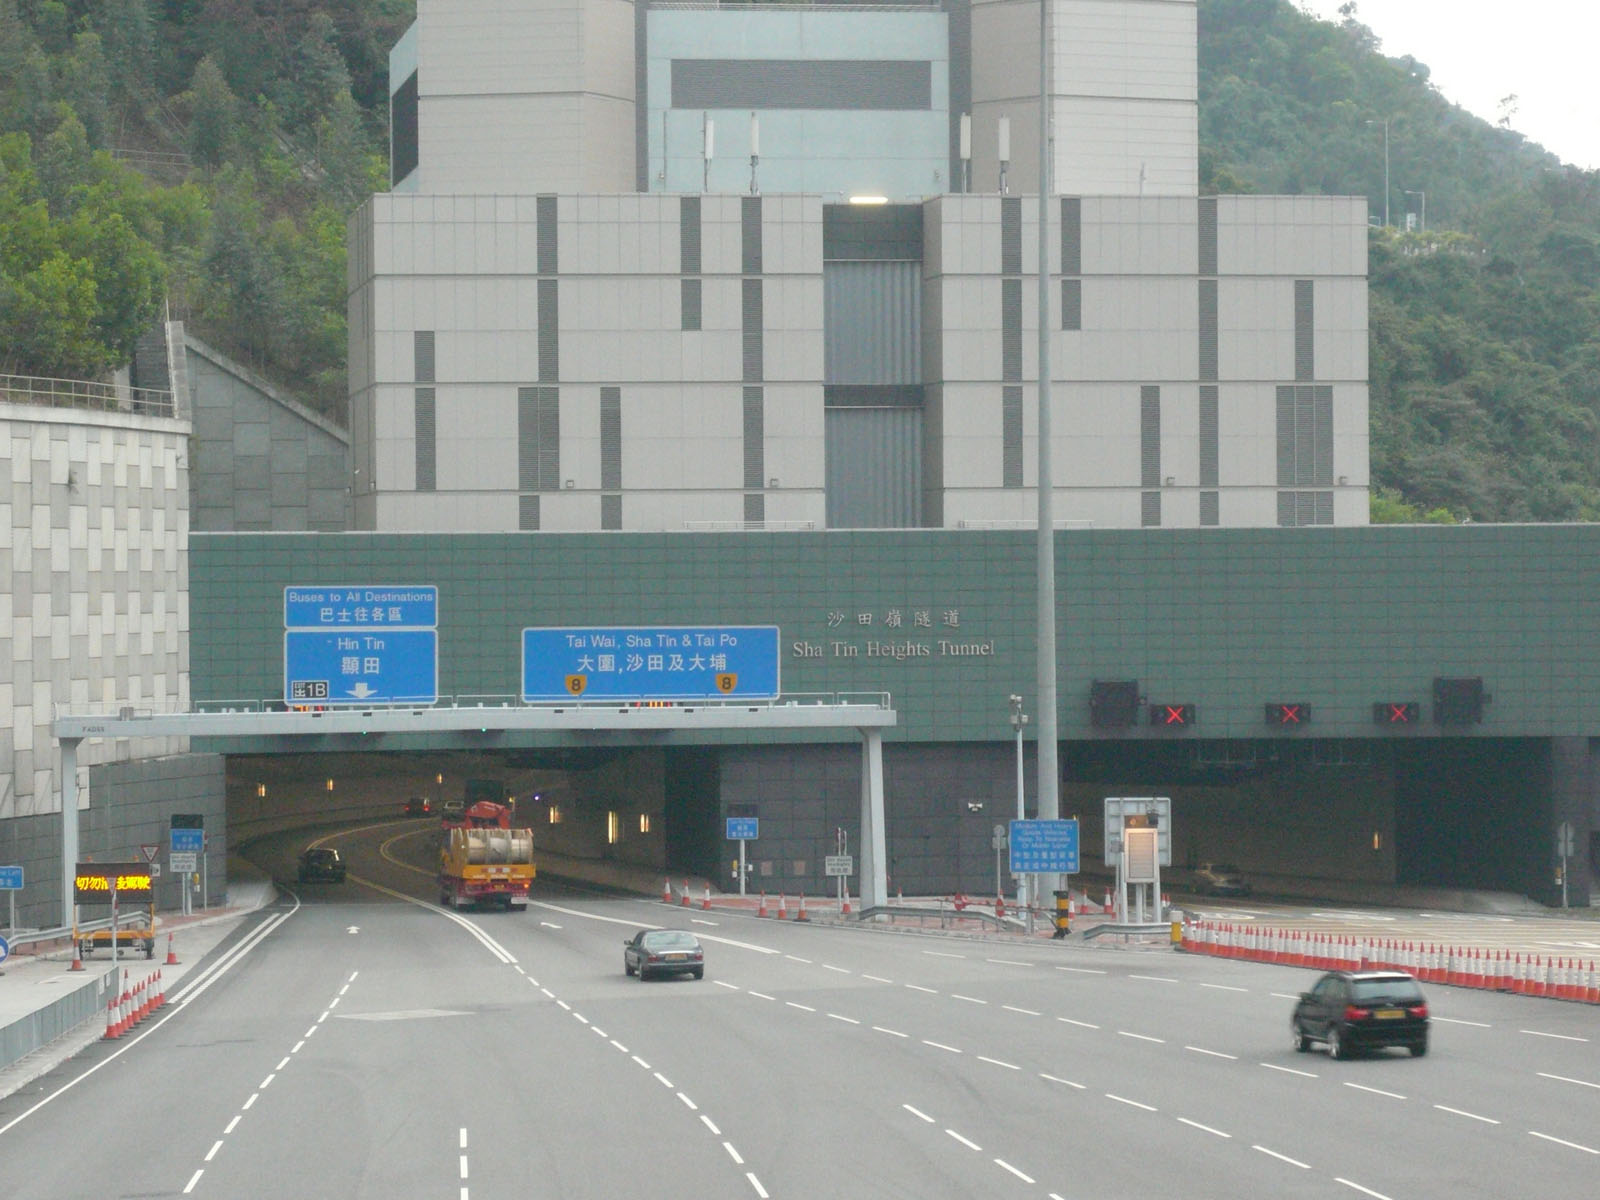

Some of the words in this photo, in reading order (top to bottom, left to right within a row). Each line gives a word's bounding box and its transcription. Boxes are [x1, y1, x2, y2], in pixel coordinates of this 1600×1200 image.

[289, 592, 324, 602] Buses
[330, 592, 341, 602] to
[346, 592, 360, 601] All
[365, 591, 433, 602] Destinations
[320, 606, 403, 622] 巴士往各區
[827, 609, 960, 629] 沙田嶺隧道
[338, 637, 359, 650] Hin
[363, 636, 385, 650] Tin
[565, 634, 586, 648] Tai
[591, 634, 621, 649] Wai,
[626, 634, 651, 648] Sha
[656, 633, 677, 648] Tin
[682, 634, 693, 647] &
[695, 633, 715, 647] Tai
[720, 633, 737, 647] Po
[793, 641, 823, 658] Sha
[831, 641, 858, 657] Tin
[867, 641, 930, 660] Heights
[938, 639, 995, 656] Tunnel
[341, 656, 380, 675] 顯田
[307, 683, 326, 697] 1B
[571, 678, 581, 692] 8
[722, 677, 732, 690] 8
